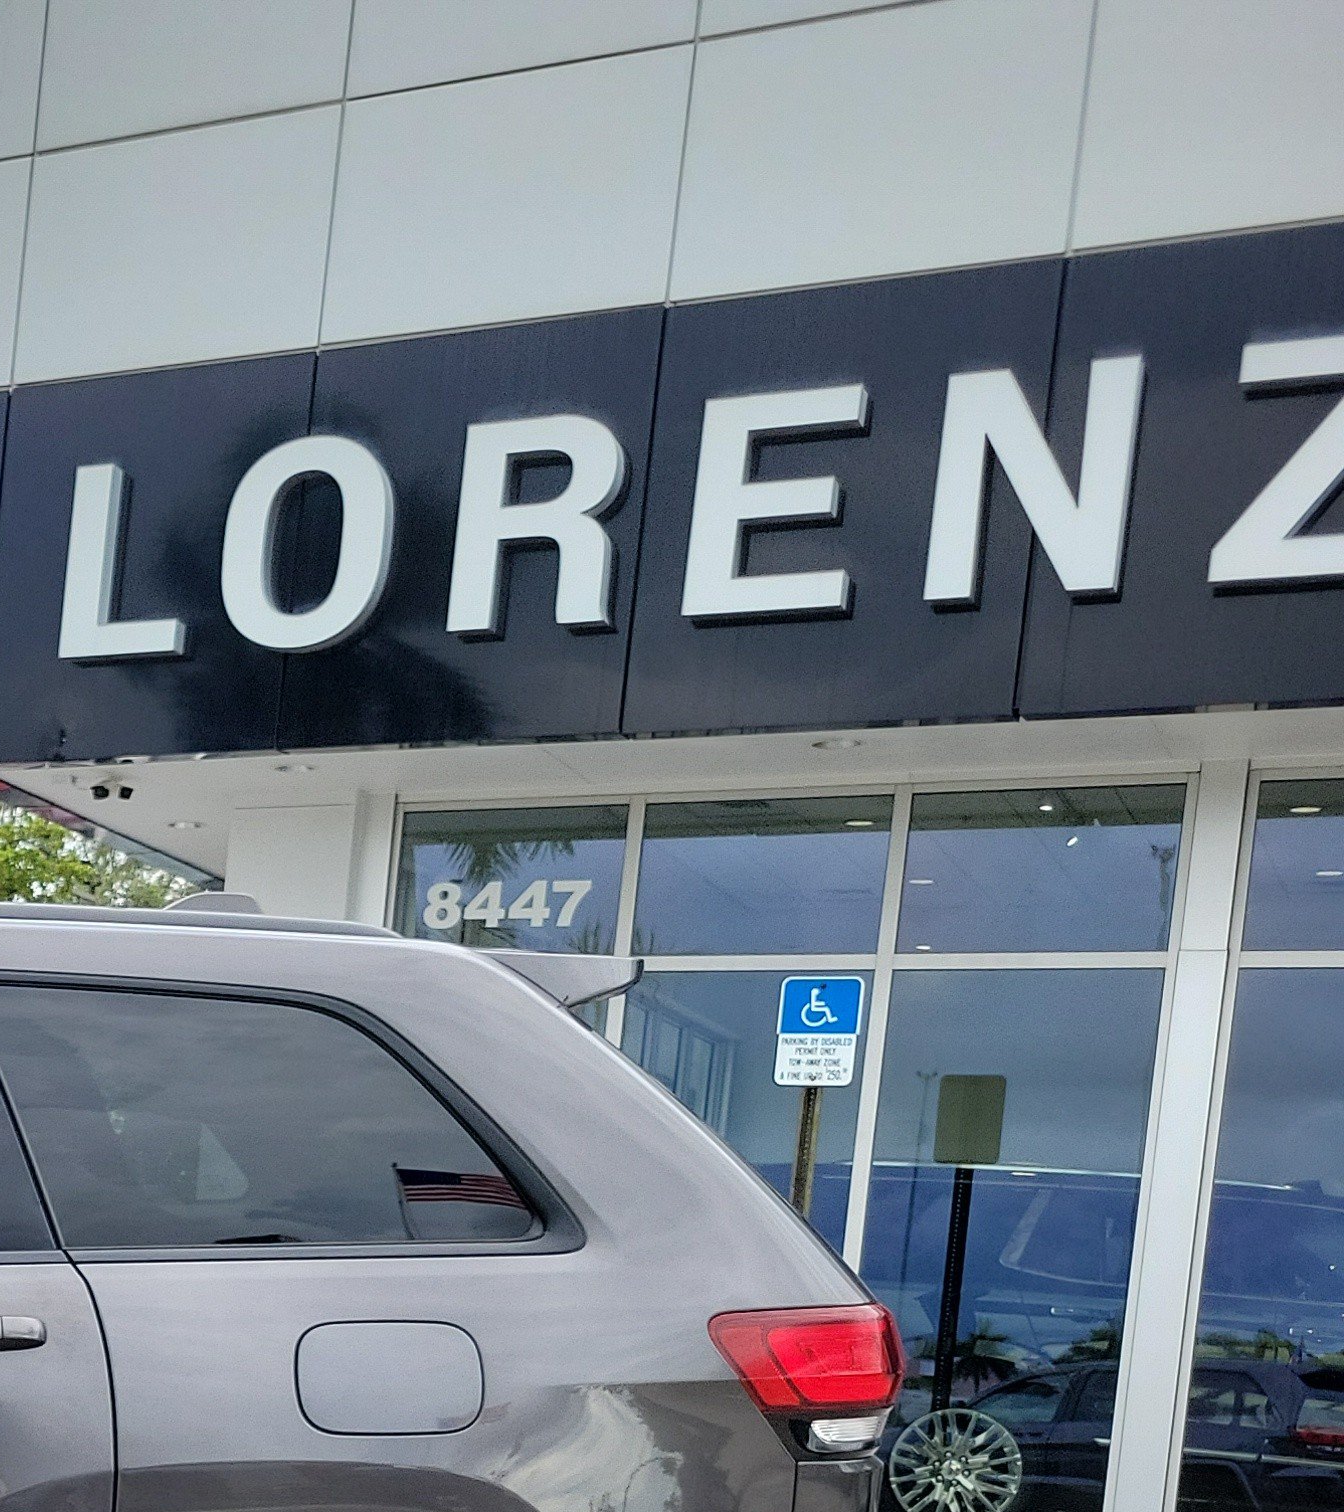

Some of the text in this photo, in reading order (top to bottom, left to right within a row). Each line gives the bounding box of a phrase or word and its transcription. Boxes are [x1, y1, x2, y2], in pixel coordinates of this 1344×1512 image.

[58, 335, 1344, 660] LORENZ
[422, 880, 593, 930] 8447
[781, 1037, 853, 1047] PARKING BY DISABLED
[794, 1047, 837, 1056] PERMIT ONLY
[823, 1058, 841, 1067] ZONE
